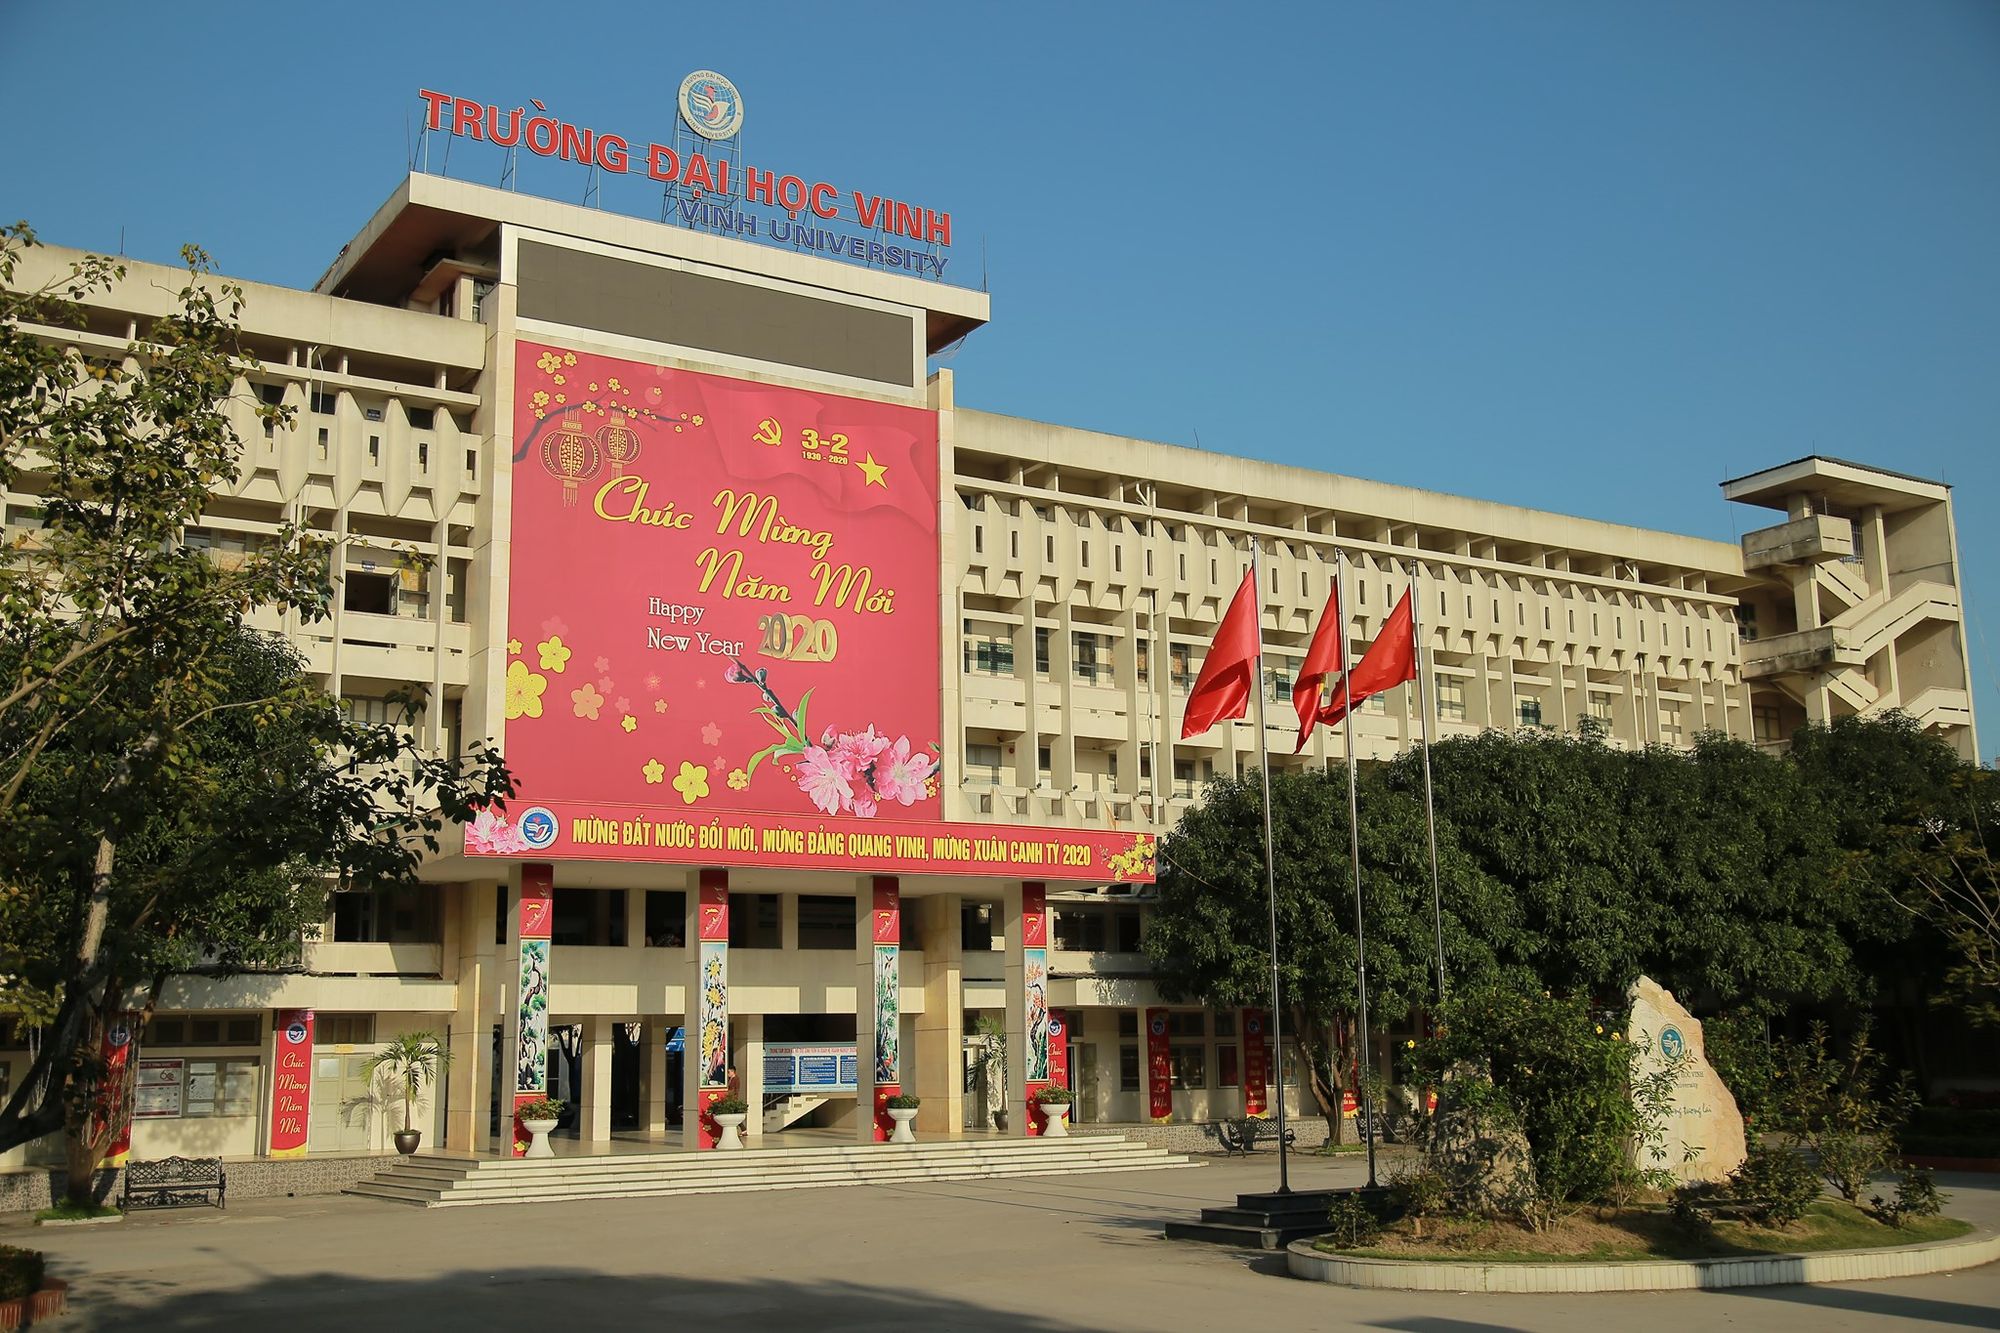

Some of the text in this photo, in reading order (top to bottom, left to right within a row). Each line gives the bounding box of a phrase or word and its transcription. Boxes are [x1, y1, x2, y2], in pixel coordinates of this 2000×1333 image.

[418, 88, 952, 246] TRƯỜNG ĐẠI HỌC VINH
[678, 199, 949, 276] VINH UNIVERSITY
[801, 428, 850, 455] 3-2
[801, 451, 821, 461] 1930
[828, 454, 849, 465] 2020
[593, 475, 834, 560] Chúc Mừng
[695, 548, 895, 615] Năm Mới
[648, 597, 705, 626] Happy
[647, 627, 744, 657] New Year
[757, 612, 838, 663] 2020
[572, 814, 619, 846] MỪNG
[622, 814, 651, 847] ĐẤT
[655, 820, 695, 849] NƯỚC
[698, 817, 723, 850] ĐỔI
[727, 825, 759, 854] MỚI,
[762, 824, 804, 854] MỪNG
[808, 824, 845, 856] ĐẢNG
[848, 834, 892, 860] QUANG
[895, 836, 929, 863] VINH,
[932, 833, 970, 862] MỪNG
[973, 834, 1008, 863] XUÂN
[1010, 841, 1043, 865] CANH
[1045, 838, 1060, 866] TÝ
[1062, 843, 1091, 867] 2020
[282, 1052, 305, 1068] Chúc
[278, 1074, 308, 1094] Mừng
[280, 1096, 303, 1112] Năm
